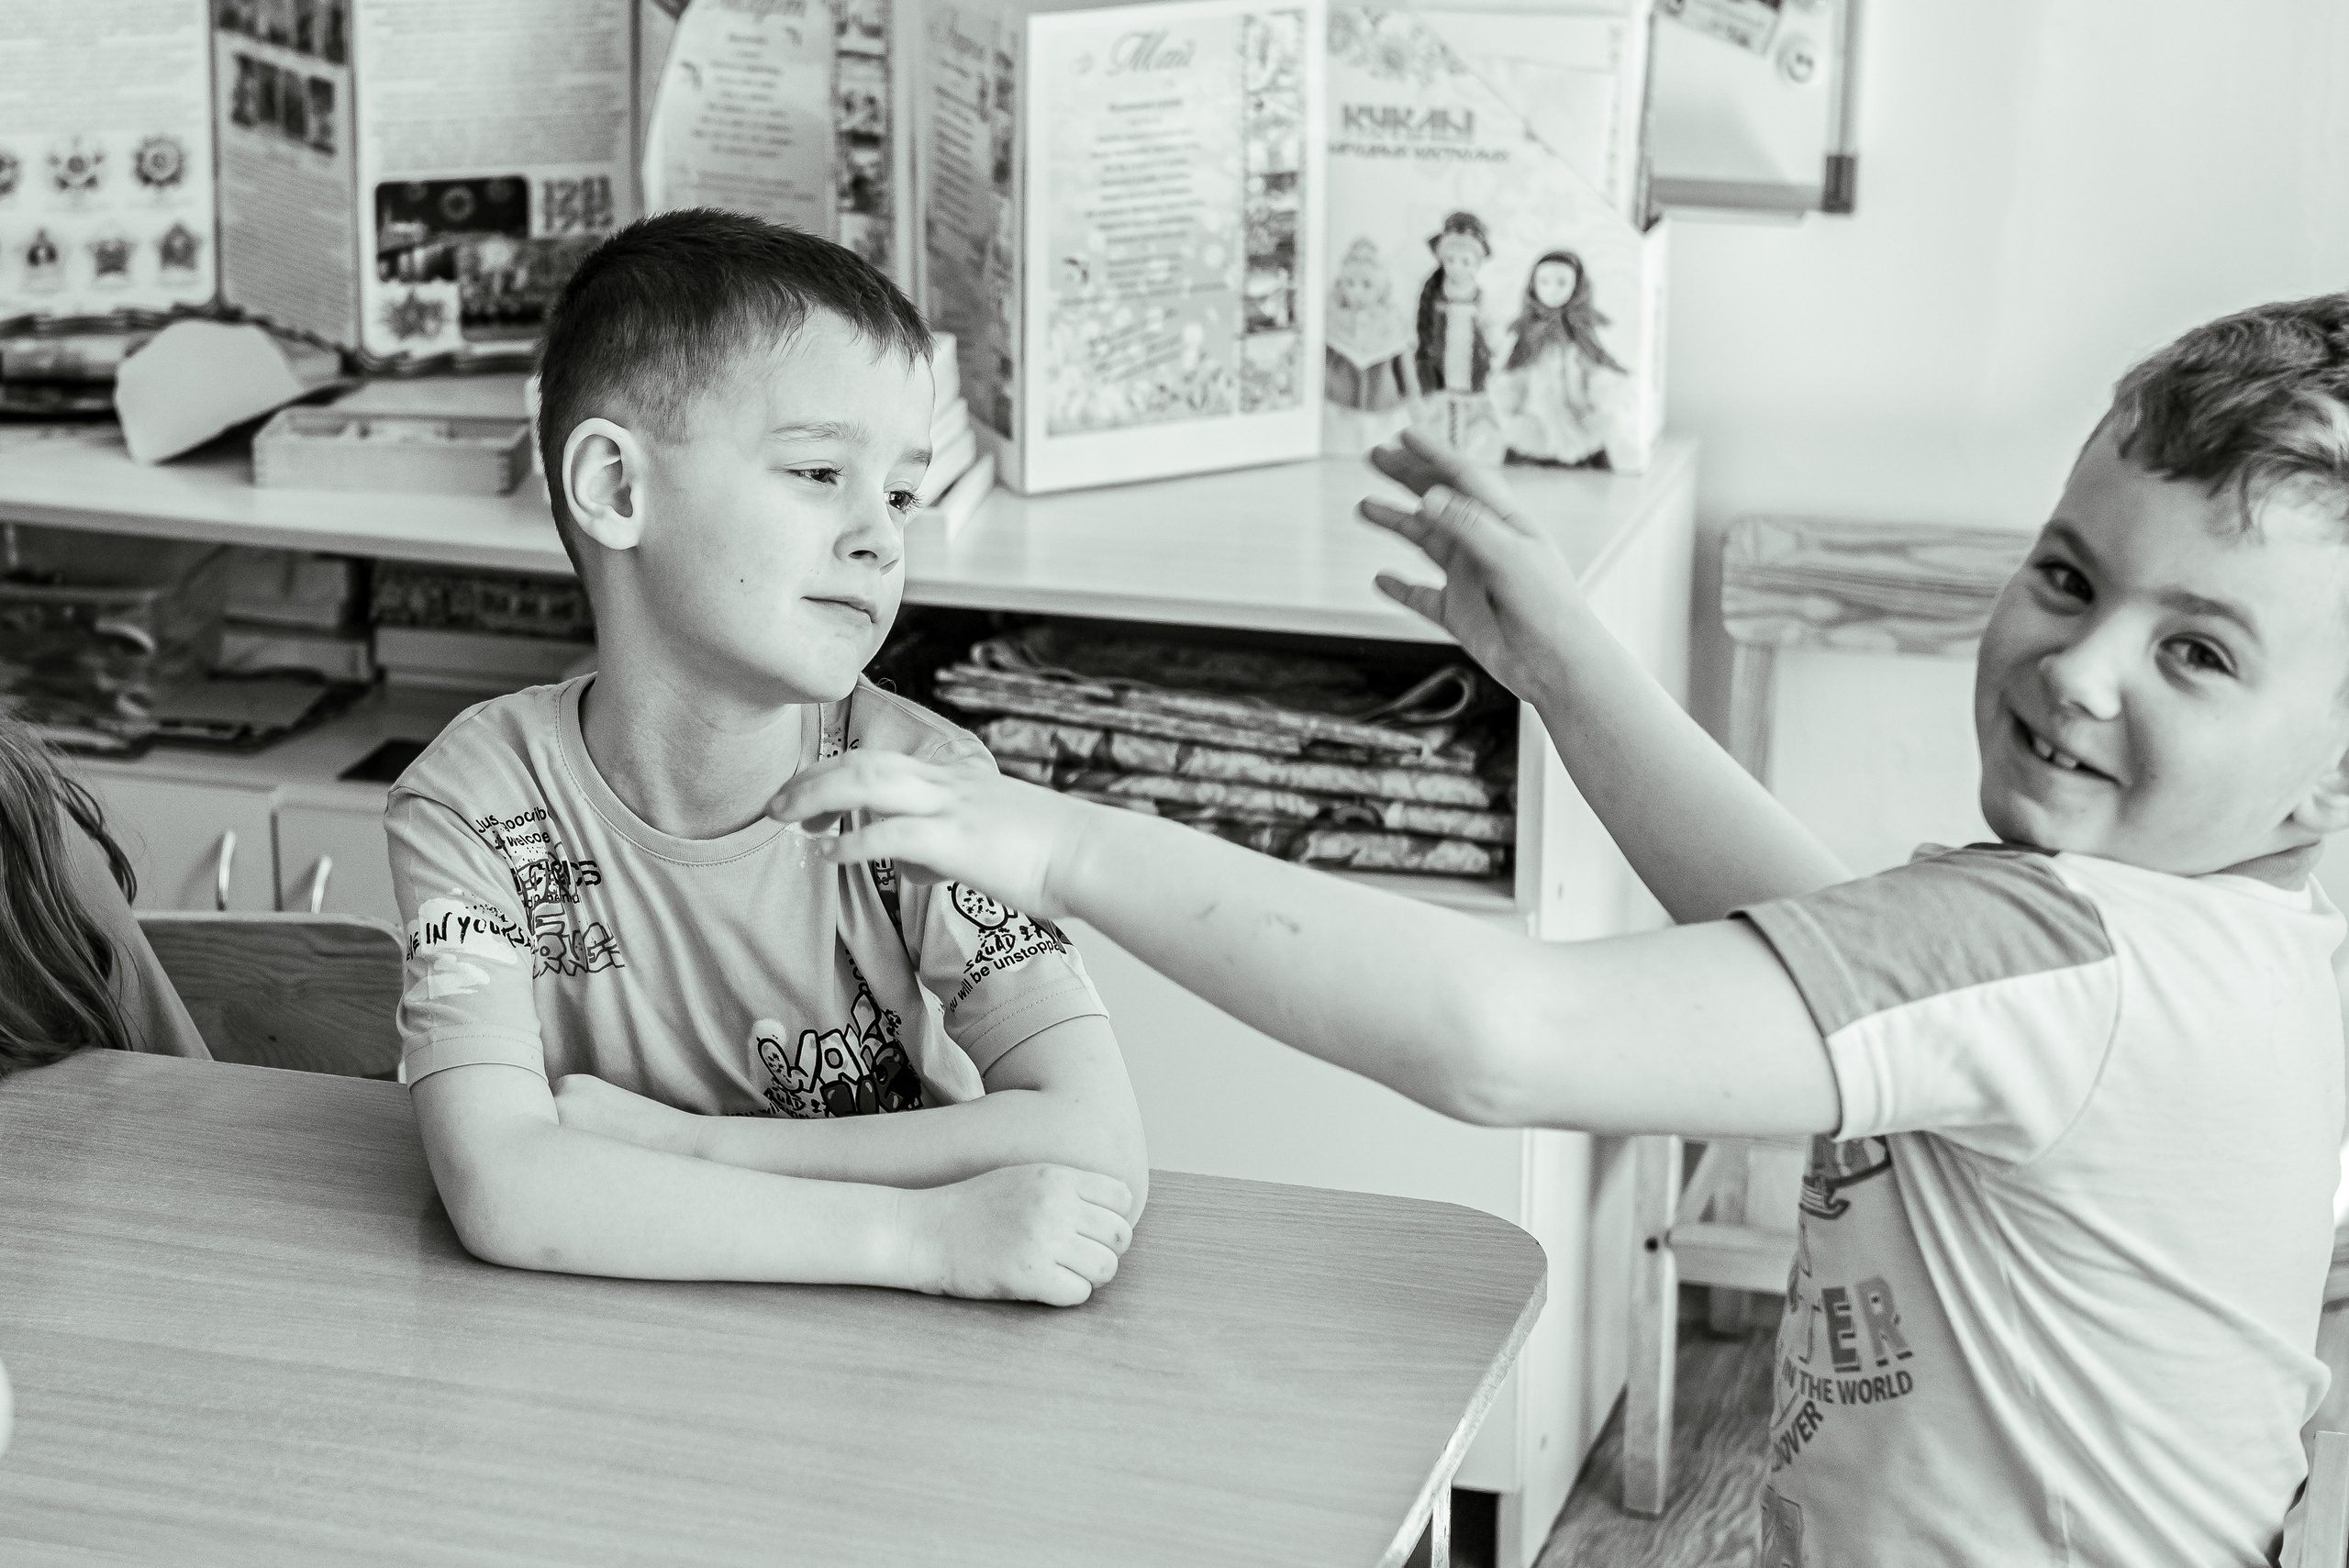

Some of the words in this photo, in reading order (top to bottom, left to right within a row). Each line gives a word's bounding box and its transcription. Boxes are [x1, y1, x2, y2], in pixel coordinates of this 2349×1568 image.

[957, 978, 974, 1000] will
[970, 966, 990, 984] be
[1798, 1370, 1833, 1404] THE
[1836, 1370, 1914, 1405] WORLD
